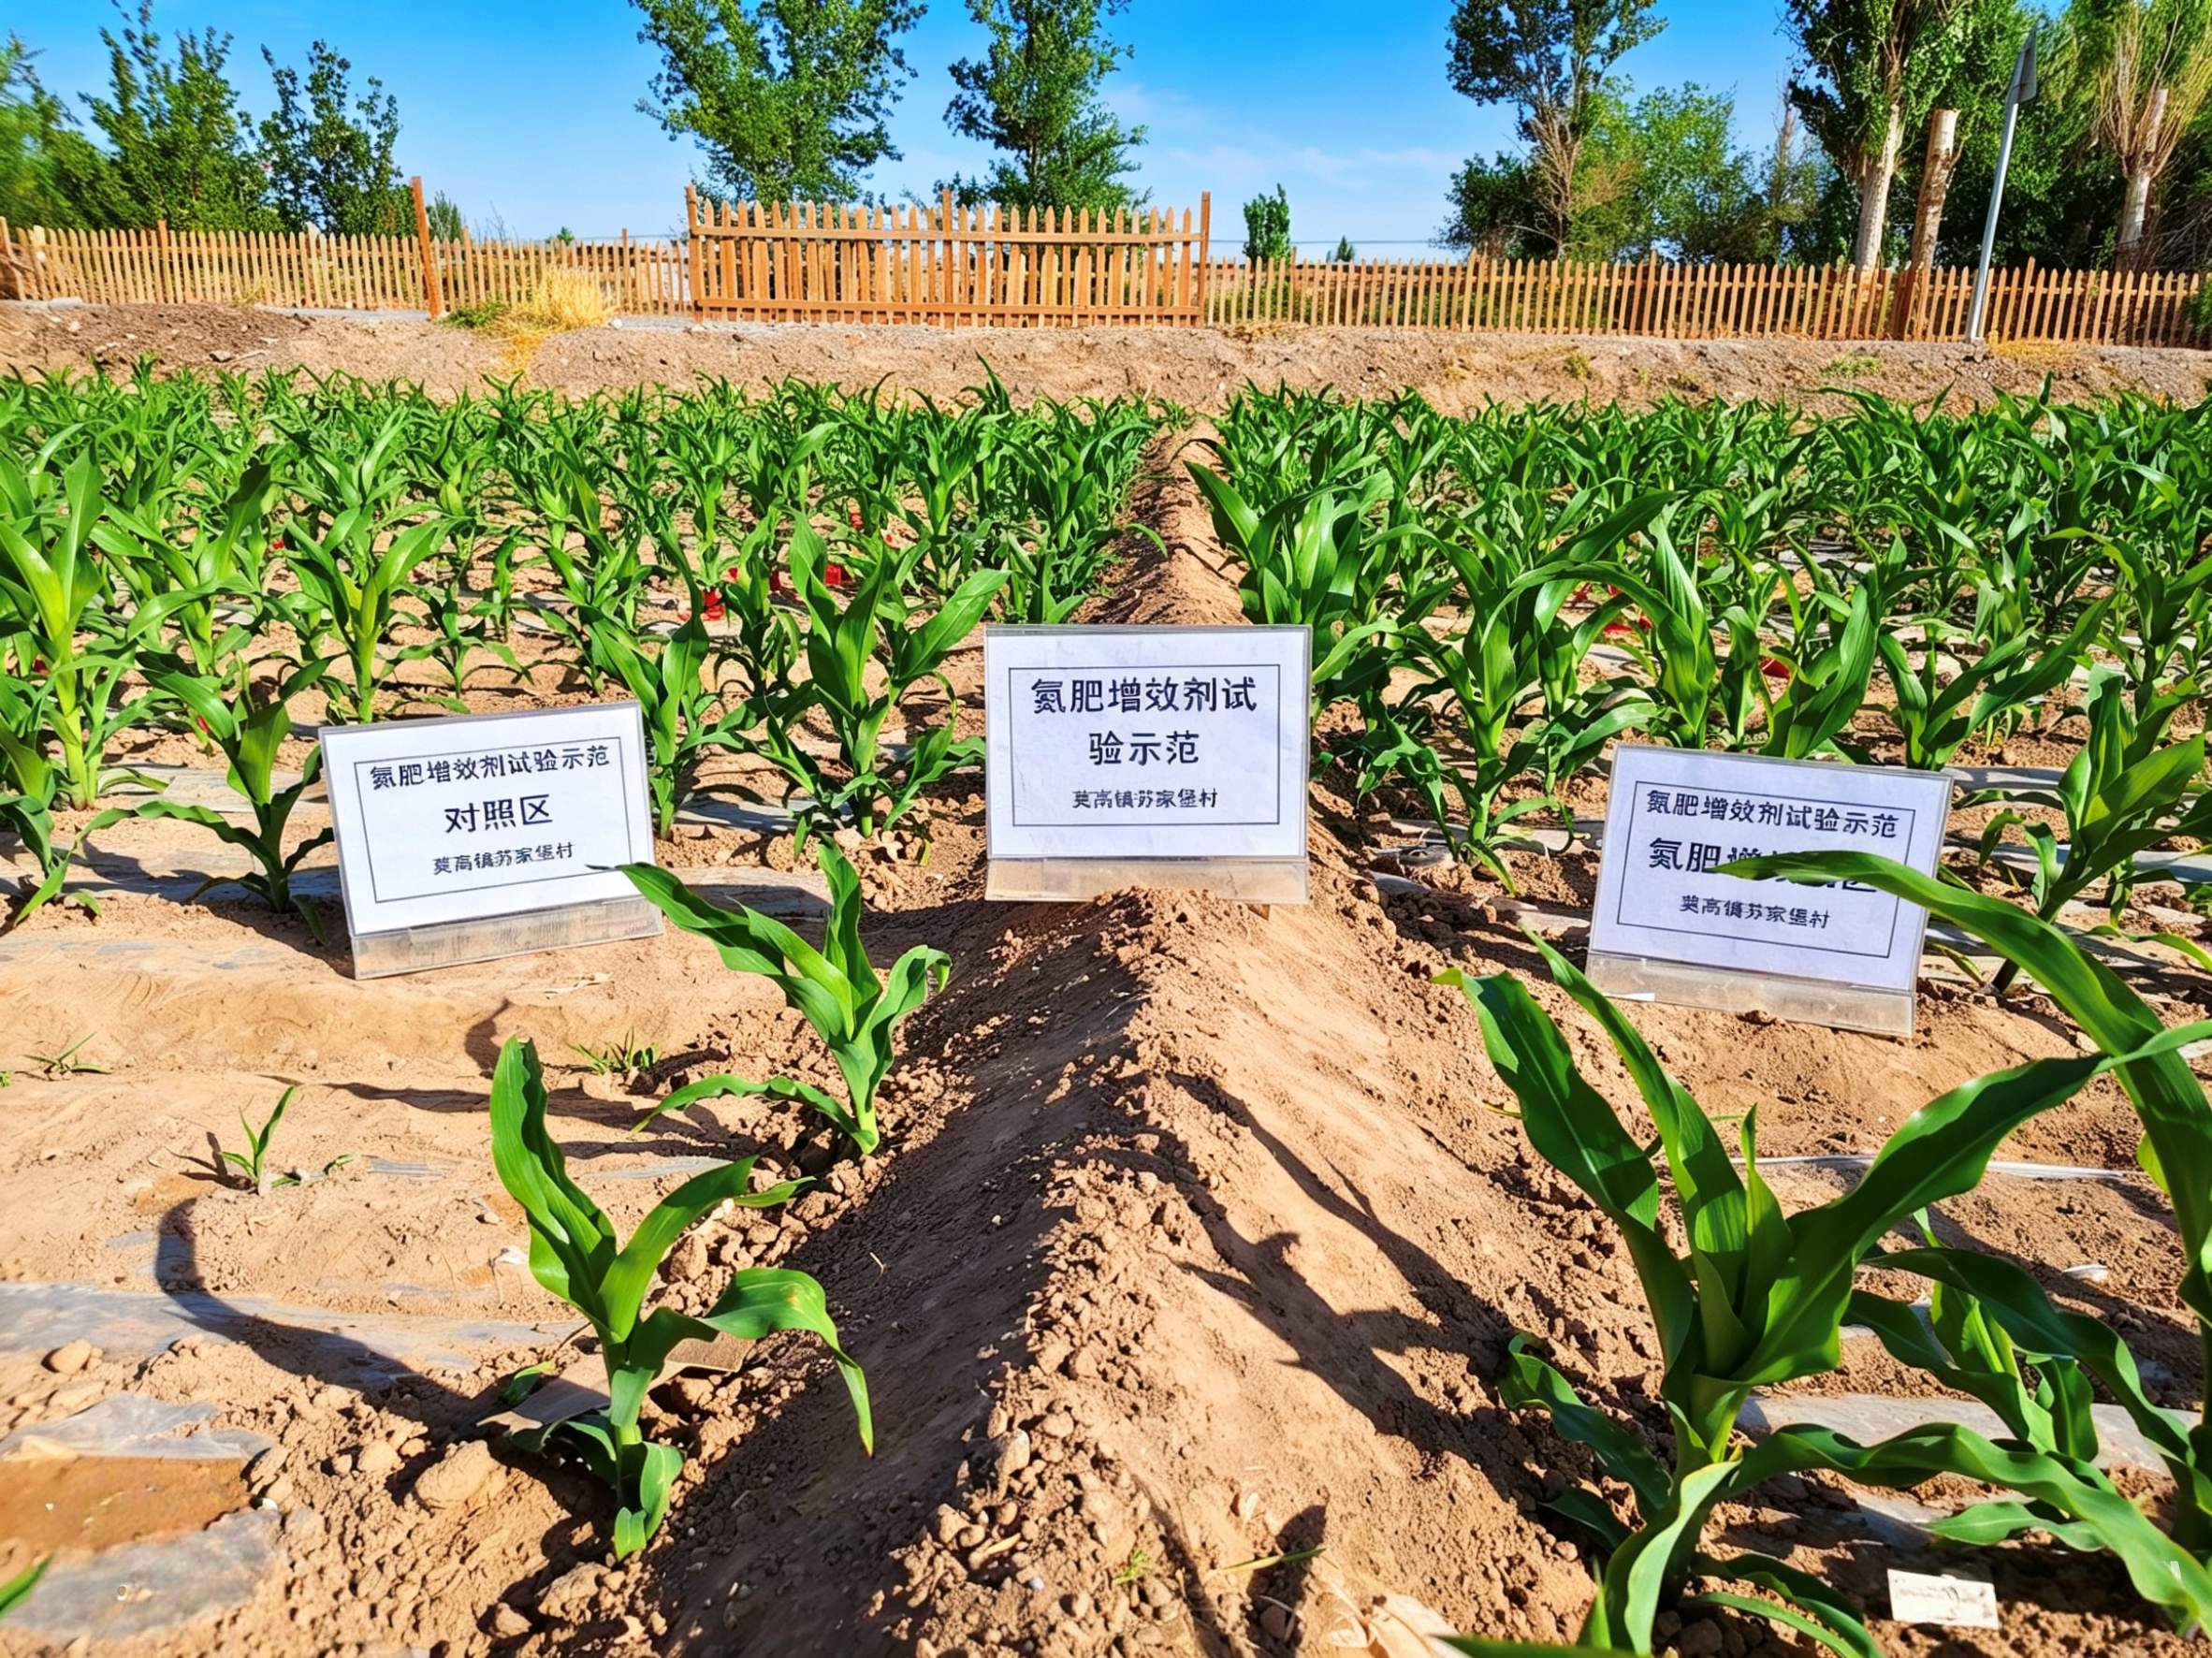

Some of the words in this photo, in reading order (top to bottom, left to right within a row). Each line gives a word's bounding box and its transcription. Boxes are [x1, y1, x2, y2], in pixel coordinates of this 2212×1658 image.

[1031, 676, 1258, 715] 氮肥增效剂试
[370, 745, 610, 791] 氮肥增效剂试验示范
[1089, 730, 1200, 766] 验示范
[444, 793, 553, 834] 对照区
[1646, 788, 1899, 838] 氮肥增效剂试验示范
